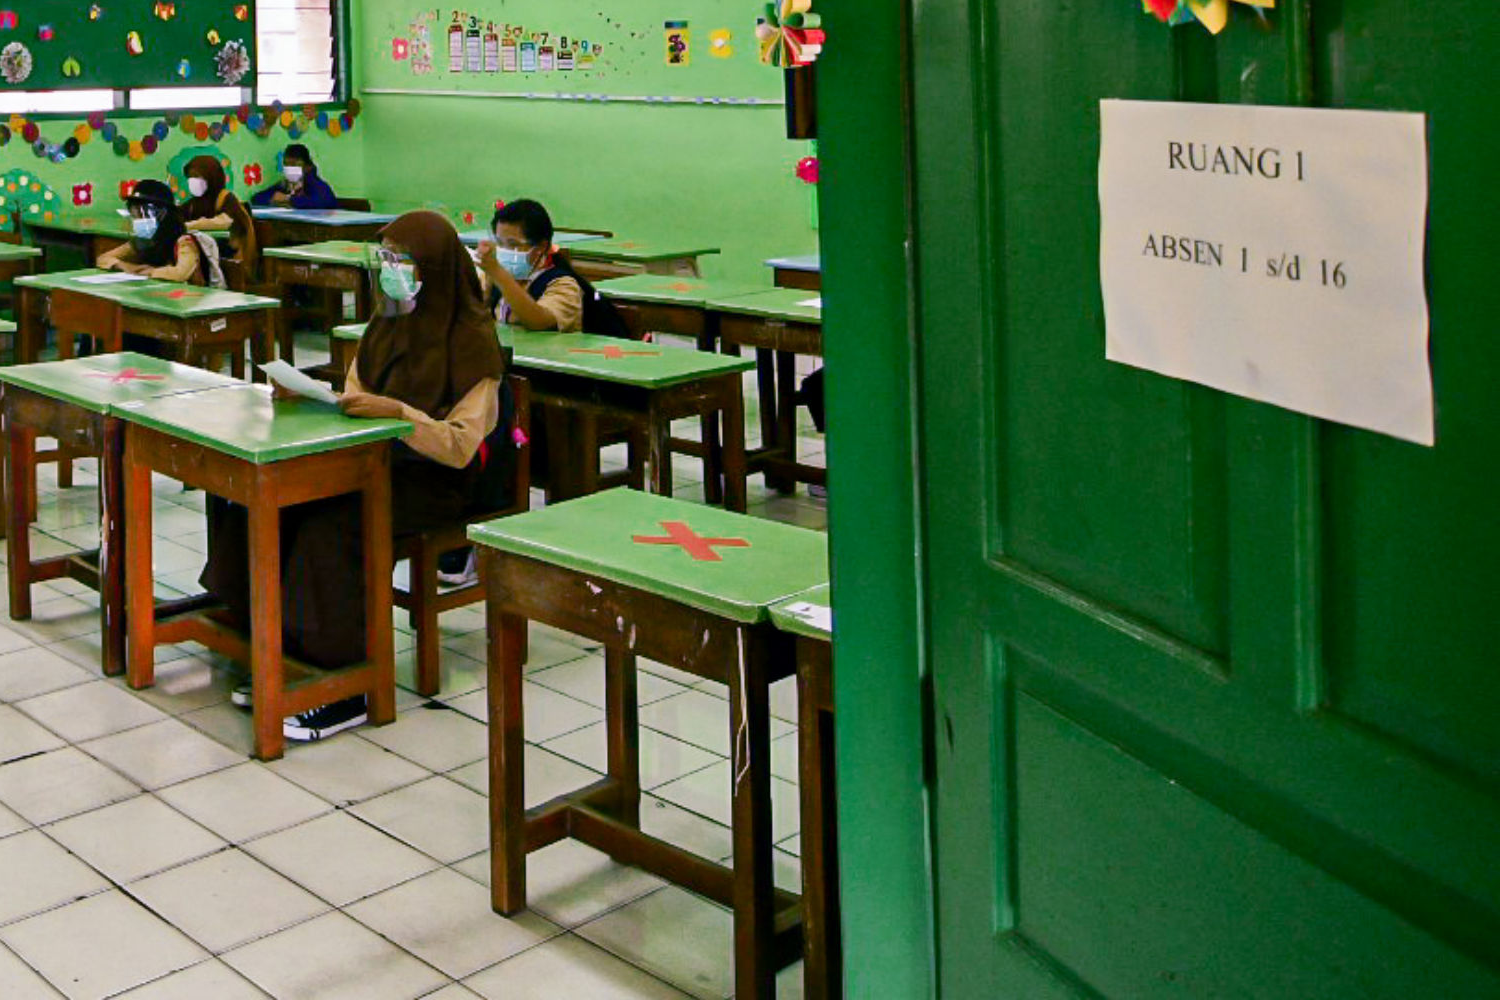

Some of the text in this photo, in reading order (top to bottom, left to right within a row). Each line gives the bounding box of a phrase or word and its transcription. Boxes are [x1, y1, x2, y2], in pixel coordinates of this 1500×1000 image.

[468, 15, 477, 28] 3
[1169, 142, 1282, 179] RUANG
[1143, 234, 1223, 267] ABSEN
[1267, 254, 1301, 281] s/d
[1321, 259, 1347, 289] 16
